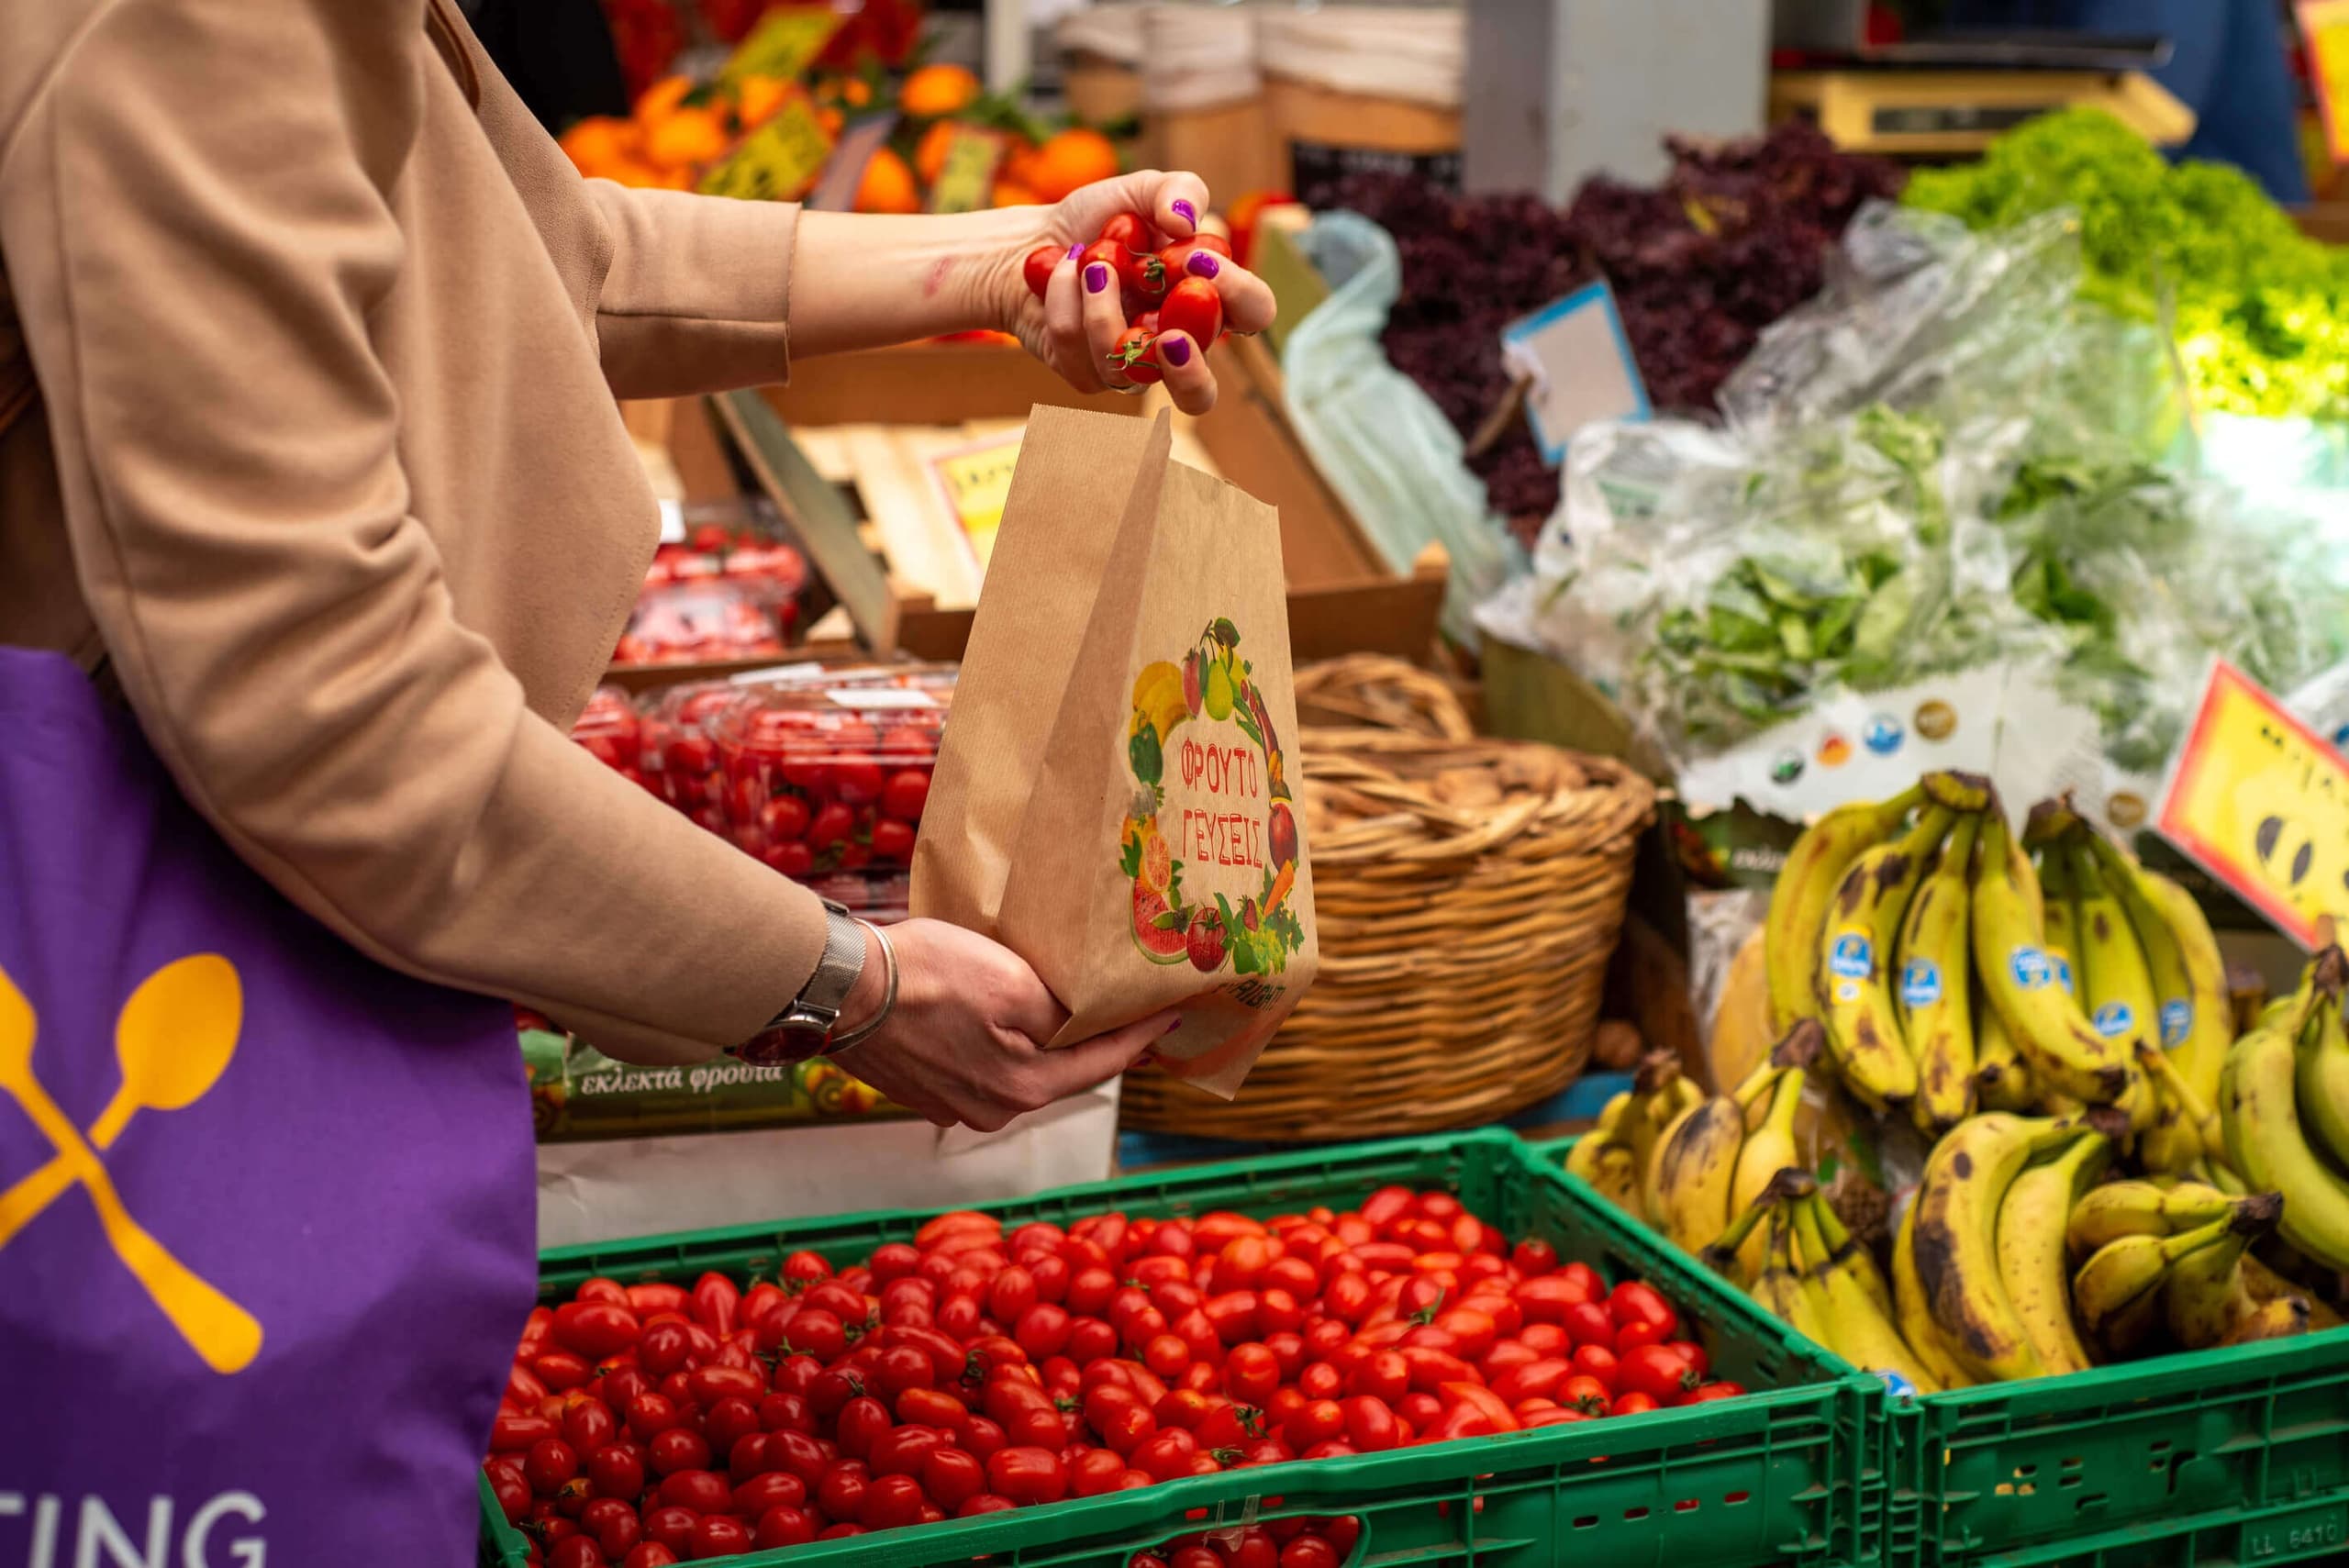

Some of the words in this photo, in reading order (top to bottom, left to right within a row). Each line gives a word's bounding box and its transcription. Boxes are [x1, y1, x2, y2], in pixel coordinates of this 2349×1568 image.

[1181, 737, 1257, 798] ΦΡΟΥΤΟ
[1183, 808, 1263, 869] ΓΕΥΣΕΙΣ
[581, 1066, 683, 1095] εκλεκτά
[0, 1490, 266, 1568] ING
